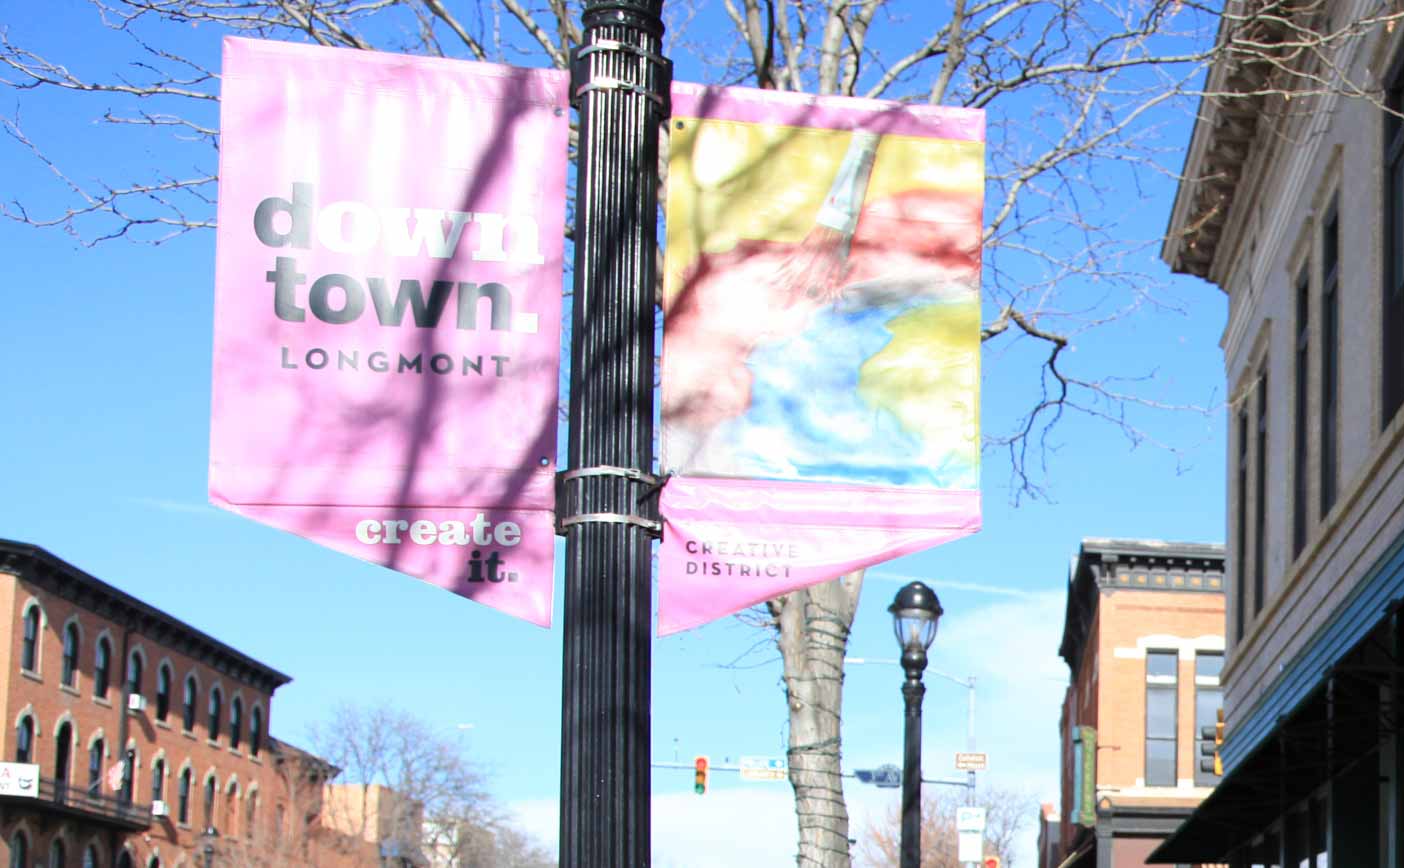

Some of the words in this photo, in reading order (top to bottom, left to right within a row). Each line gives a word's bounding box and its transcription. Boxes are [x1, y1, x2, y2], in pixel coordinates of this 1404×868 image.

[253, 181, 545, 265] down
[266, 256, 538, 333] town.
[280, 346, 511, 378] LONGMONT
[355, 512, 521, 546] create
[685, 540, 799, 559] CREATIVE
[467, 550, 518, 583] it.
[686, 561, 792, 578] DISTRICT
